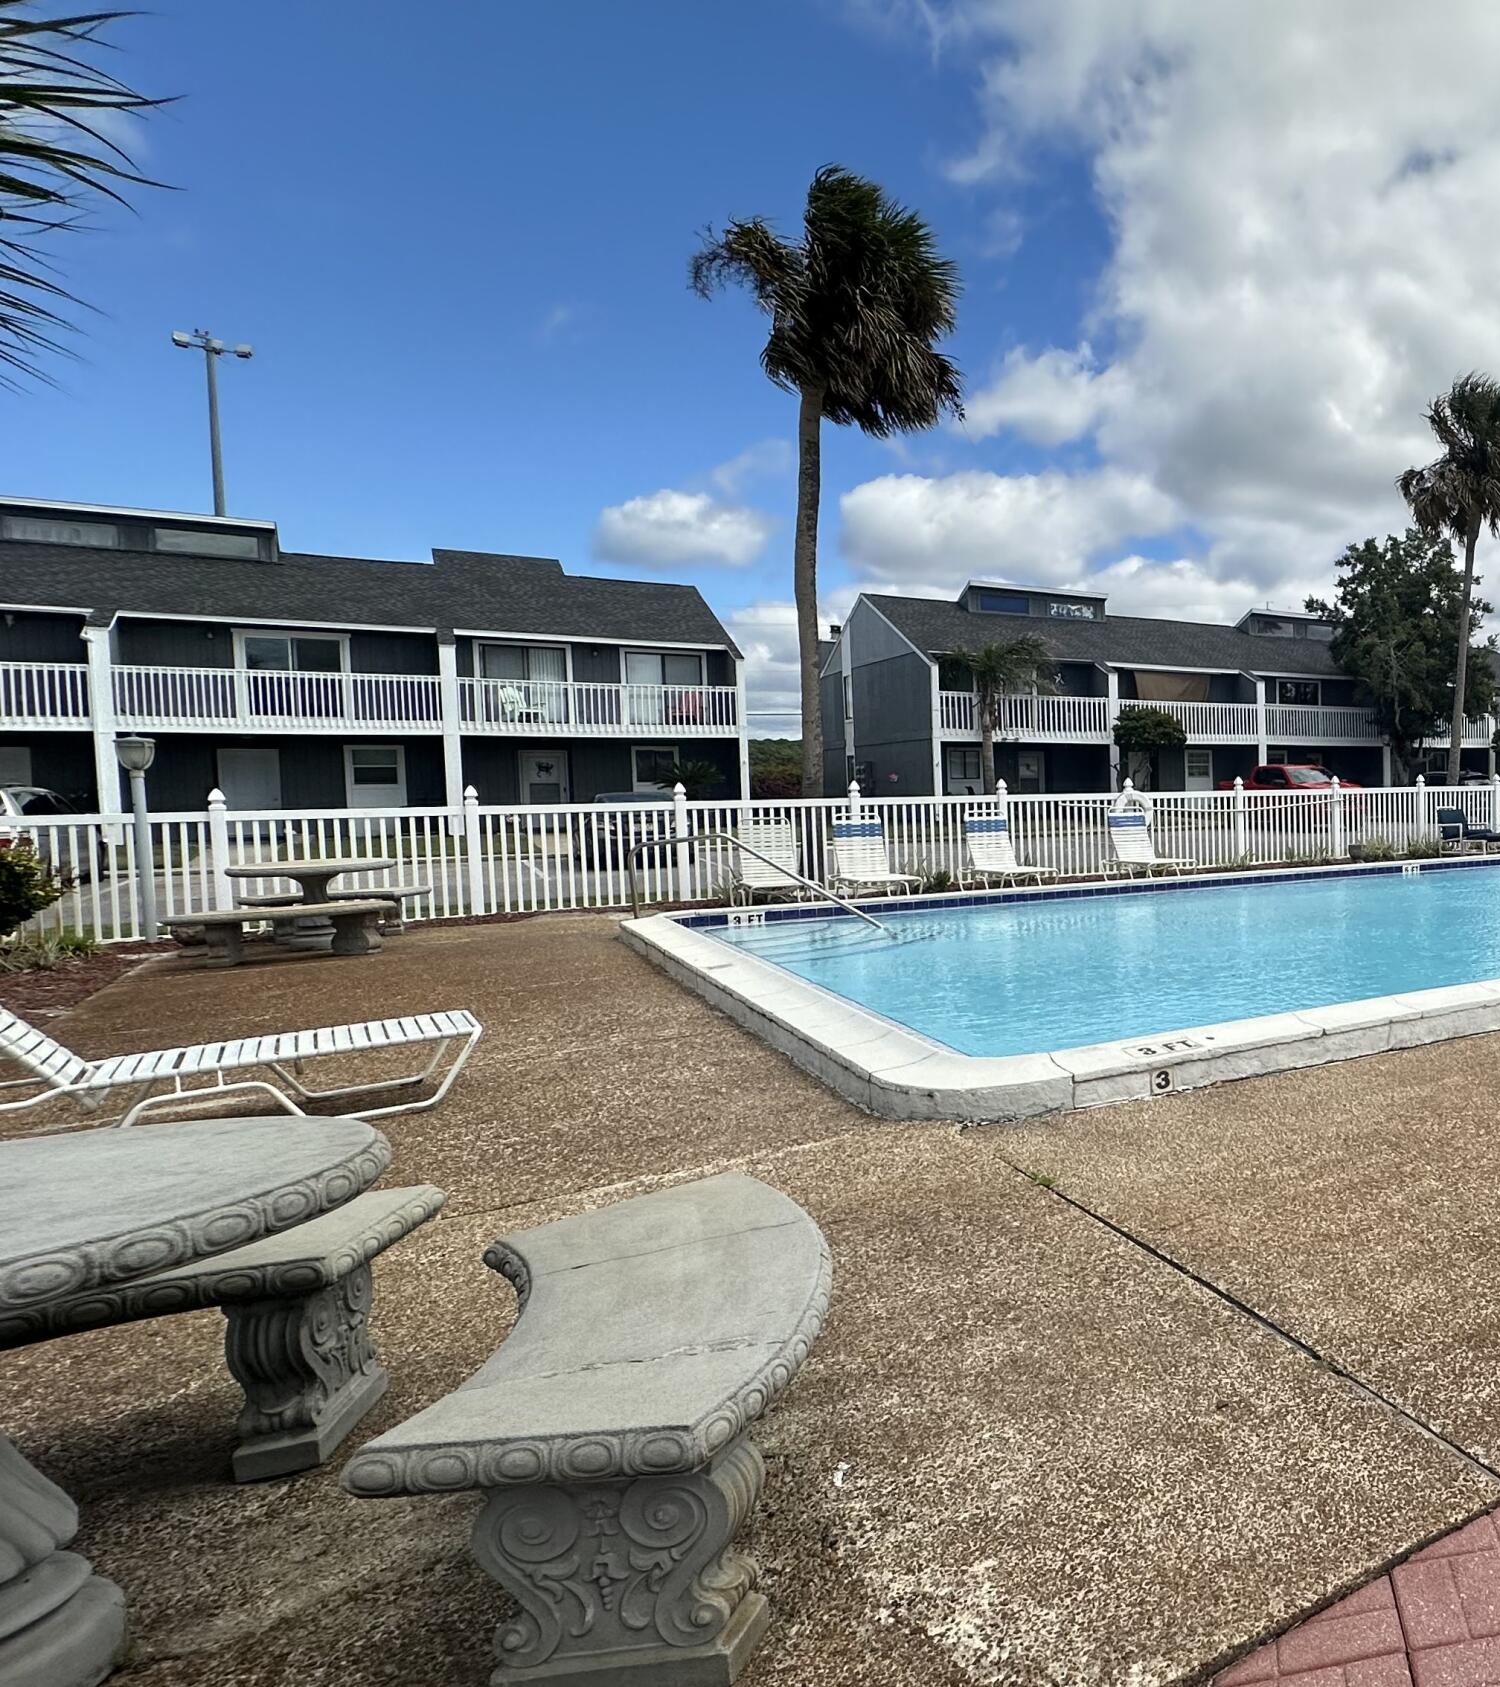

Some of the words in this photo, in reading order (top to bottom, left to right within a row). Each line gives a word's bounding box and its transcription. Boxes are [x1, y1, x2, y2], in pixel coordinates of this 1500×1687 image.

[747, 913, 764, 924] FT
[1137, 1047, 1158, 1056] 3
[1161, 1039, 1194, 1051] FT
[1155, 1070, 1171, 1090] 3
